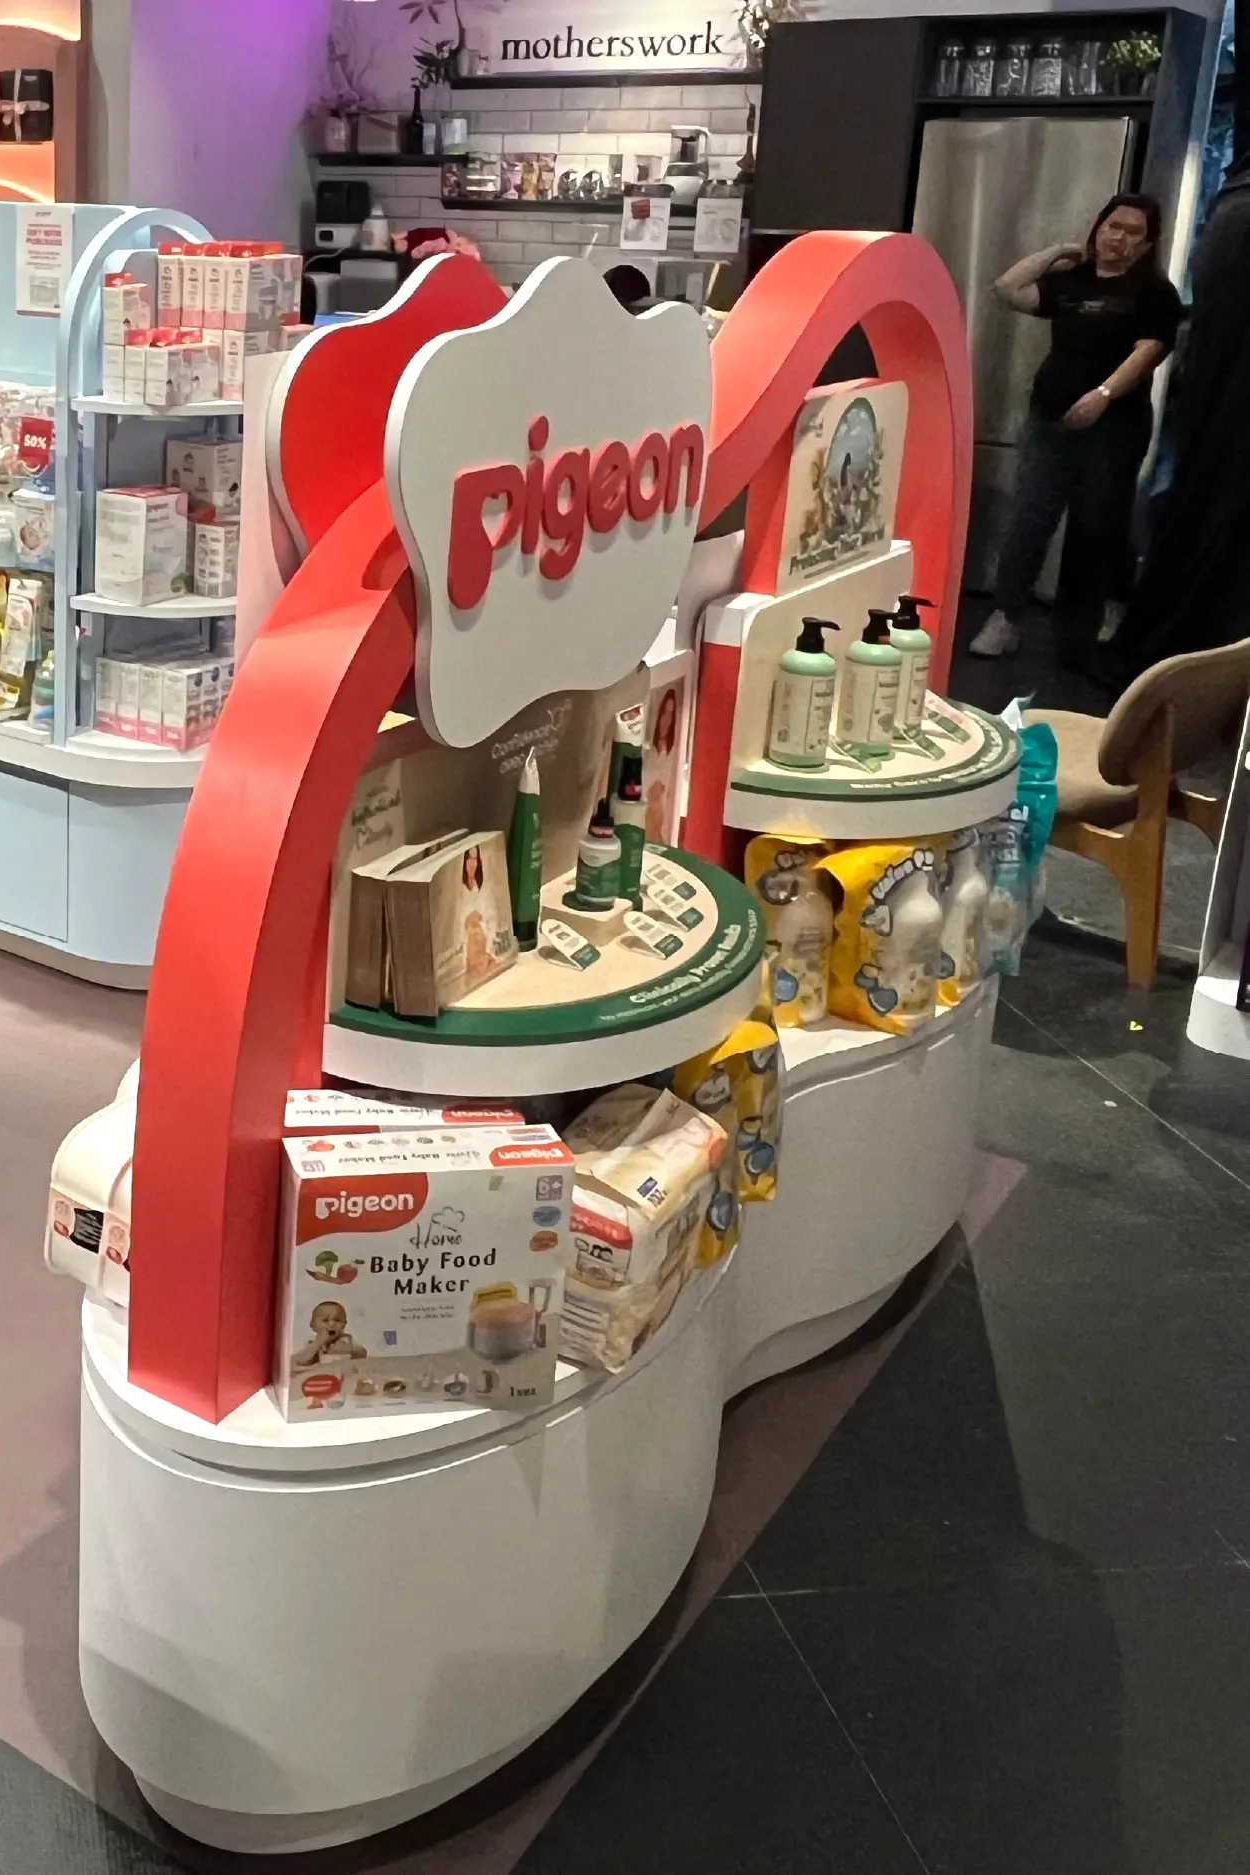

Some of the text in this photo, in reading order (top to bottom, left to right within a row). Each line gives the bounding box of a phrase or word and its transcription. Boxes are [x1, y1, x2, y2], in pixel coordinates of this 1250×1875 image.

[502, 21, 724, 60] motherswork
[23, 433, 47, 449] 50%
[447, 415, 704, 610] pigeon
[315, 1190, 415, 1220] pigeon
[370, 1248, 496, 1276] Baby Food
[394, 1275, 470, 1295] Maker
